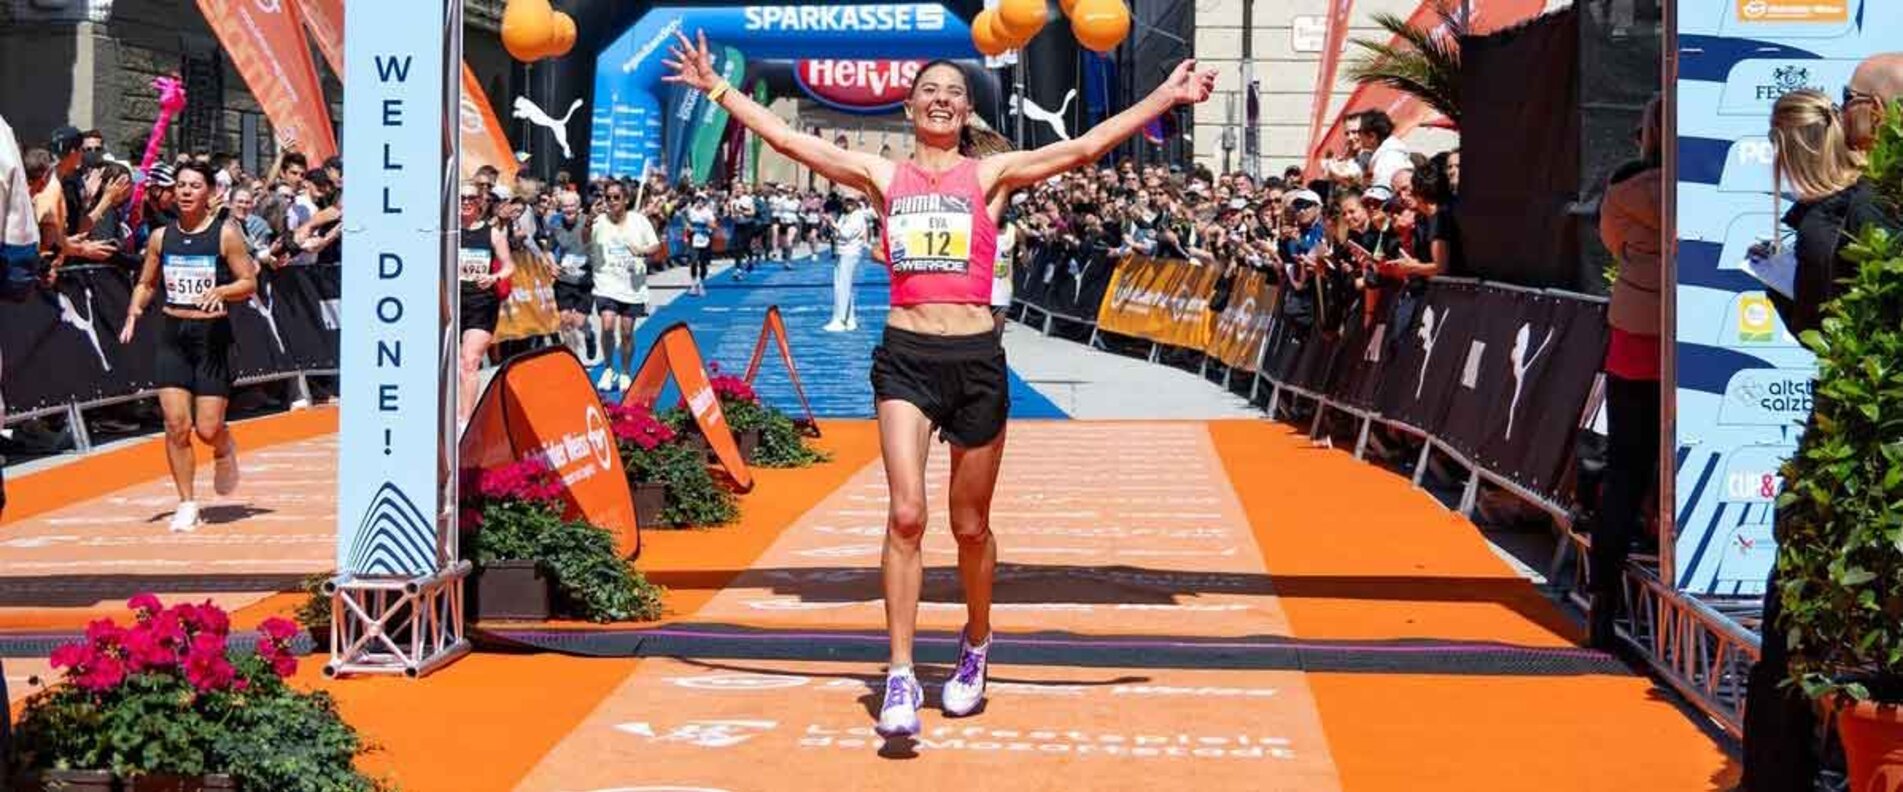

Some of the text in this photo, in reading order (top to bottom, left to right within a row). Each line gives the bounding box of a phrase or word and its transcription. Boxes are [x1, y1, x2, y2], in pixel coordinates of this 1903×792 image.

[745, 6, 911, 30] SPARKASSE
[374, 55, 412, 214] WELL
[929, 217, 949, 229] EVA
[923, 231, 951, 256] 12
[178, 279, 213, 294] 5169
